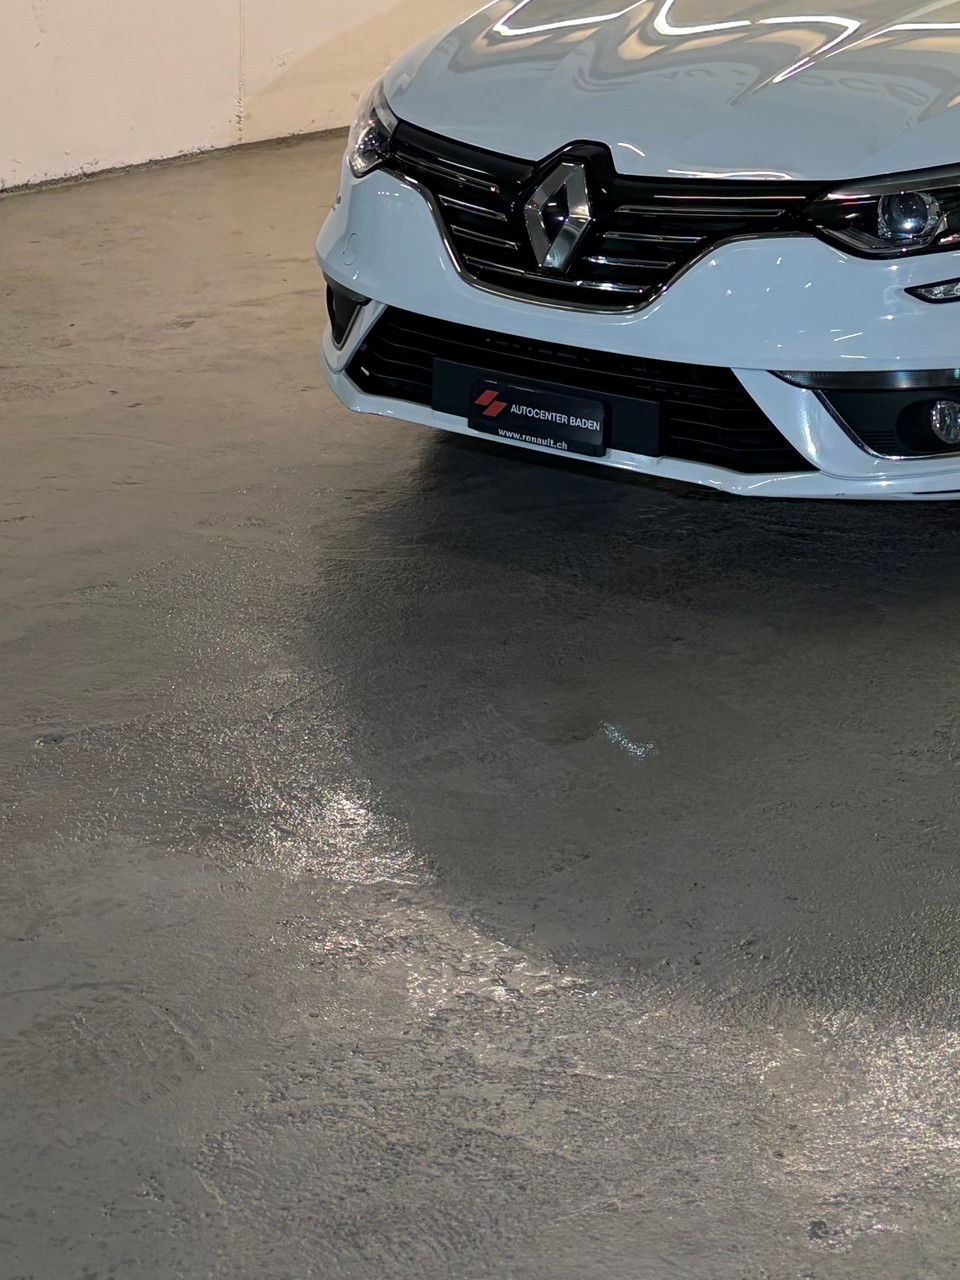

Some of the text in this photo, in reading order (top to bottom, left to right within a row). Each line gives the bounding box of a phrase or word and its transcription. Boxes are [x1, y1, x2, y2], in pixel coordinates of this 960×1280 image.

[510, 403, 600, 431] AUTOCENTER BADEN
[498, 428, 568, 450] www.renault.ch
